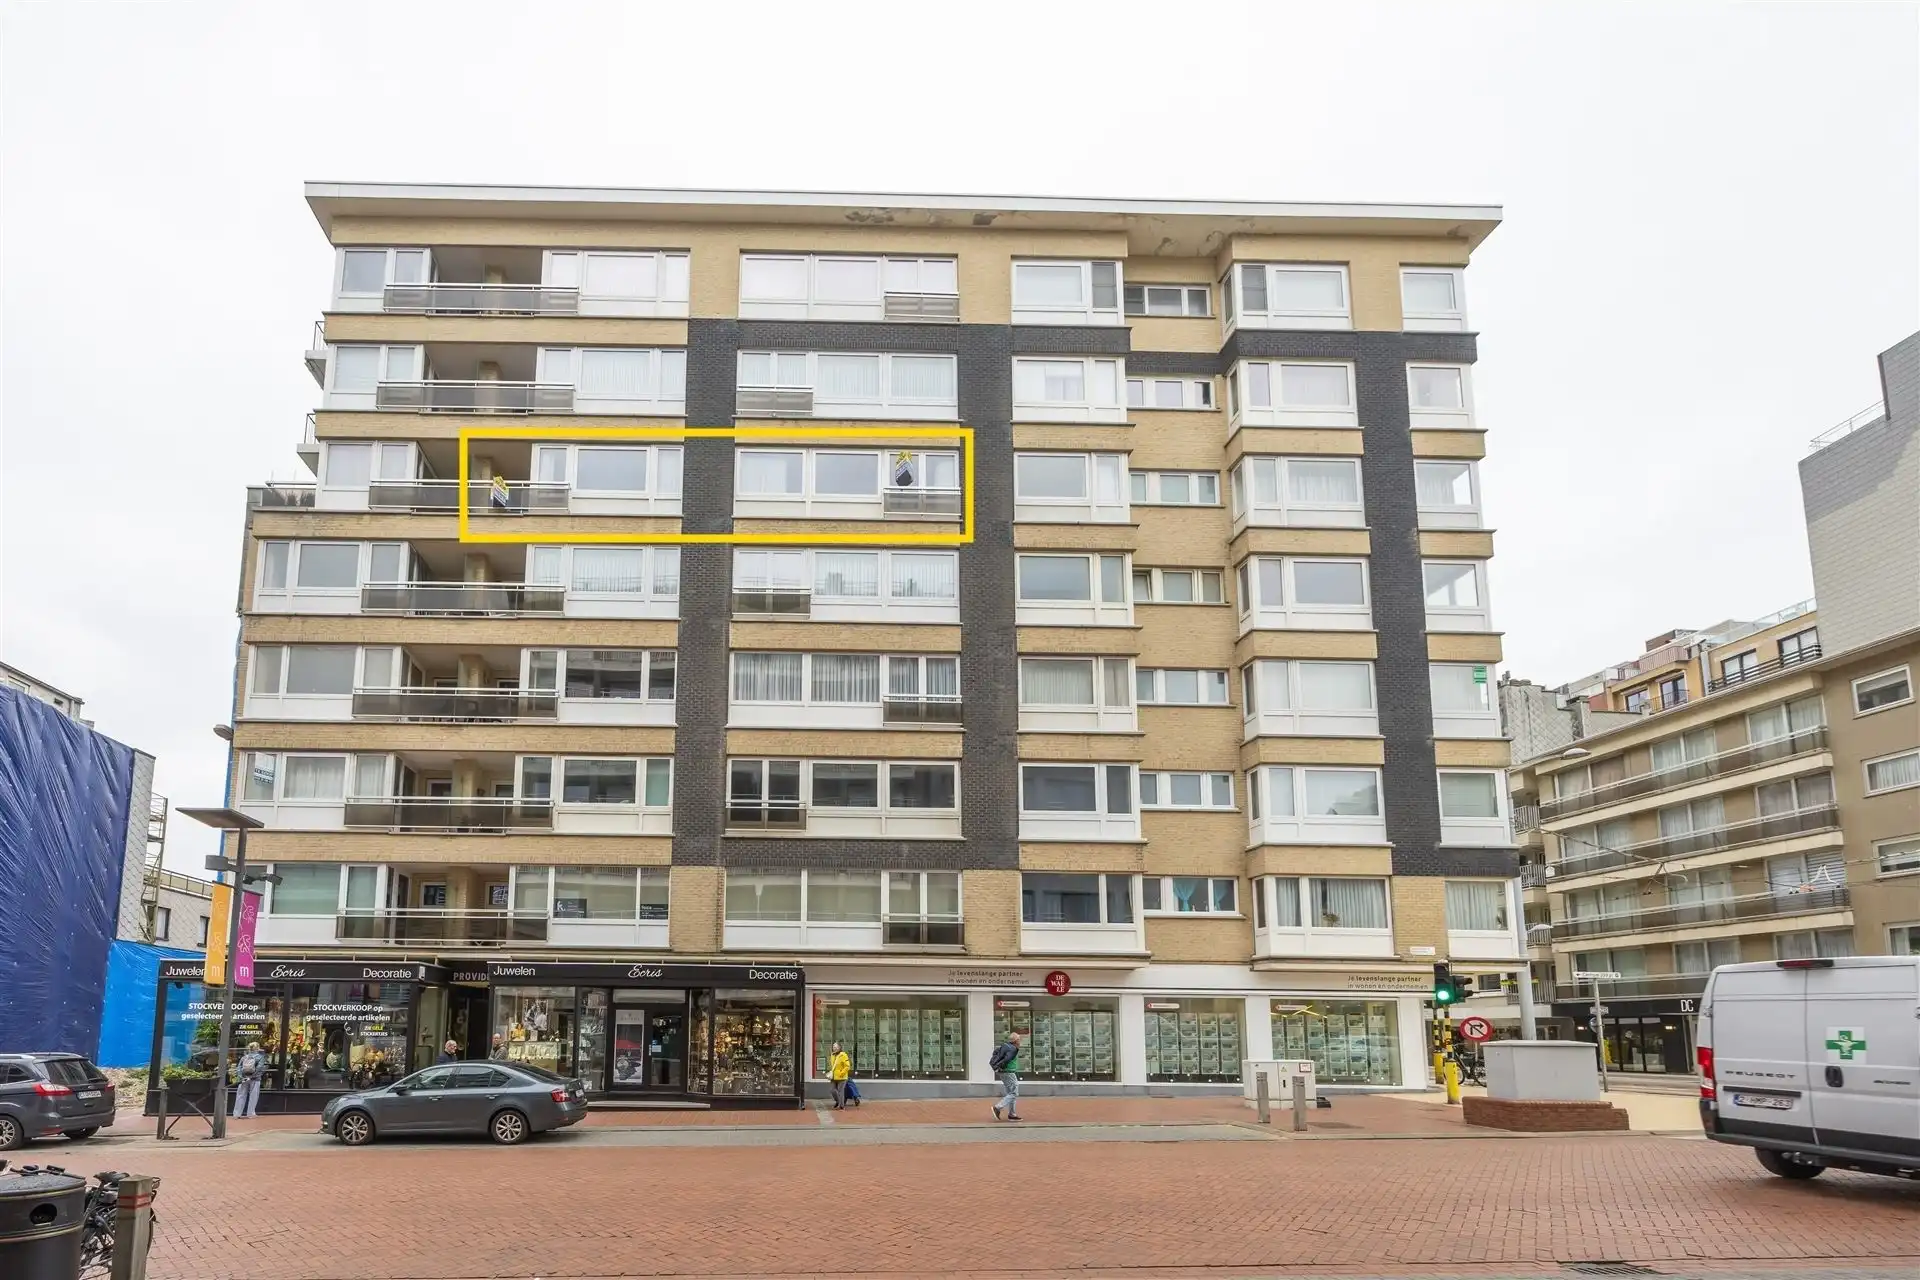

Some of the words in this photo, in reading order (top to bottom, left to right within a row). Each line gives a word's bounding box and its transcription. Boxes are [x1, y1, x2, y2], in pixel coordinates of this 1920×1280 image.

[240, 966, 249, 977] m
[363, 968, 412, 978] Decoratie
[493, 966, 536, 976] Juwelen
[749, 970, 798, 980] Decoratie
[956, 970, 997, 978] levenslange
[248, 1004, 259, 1012] op
[373, 1005, 384, 1013] op
[1680, 999, 1694, 1012] DC
[181, 1012, 232, 1021] geselecteer
[232, 1011, 265, 1020] artikelen
[306, 1013, 357, 1022] geselecteerde
[358, 1013, 391, 1021] artikelen
[1725, 1070, 1796, 1079] PEUGEOT
